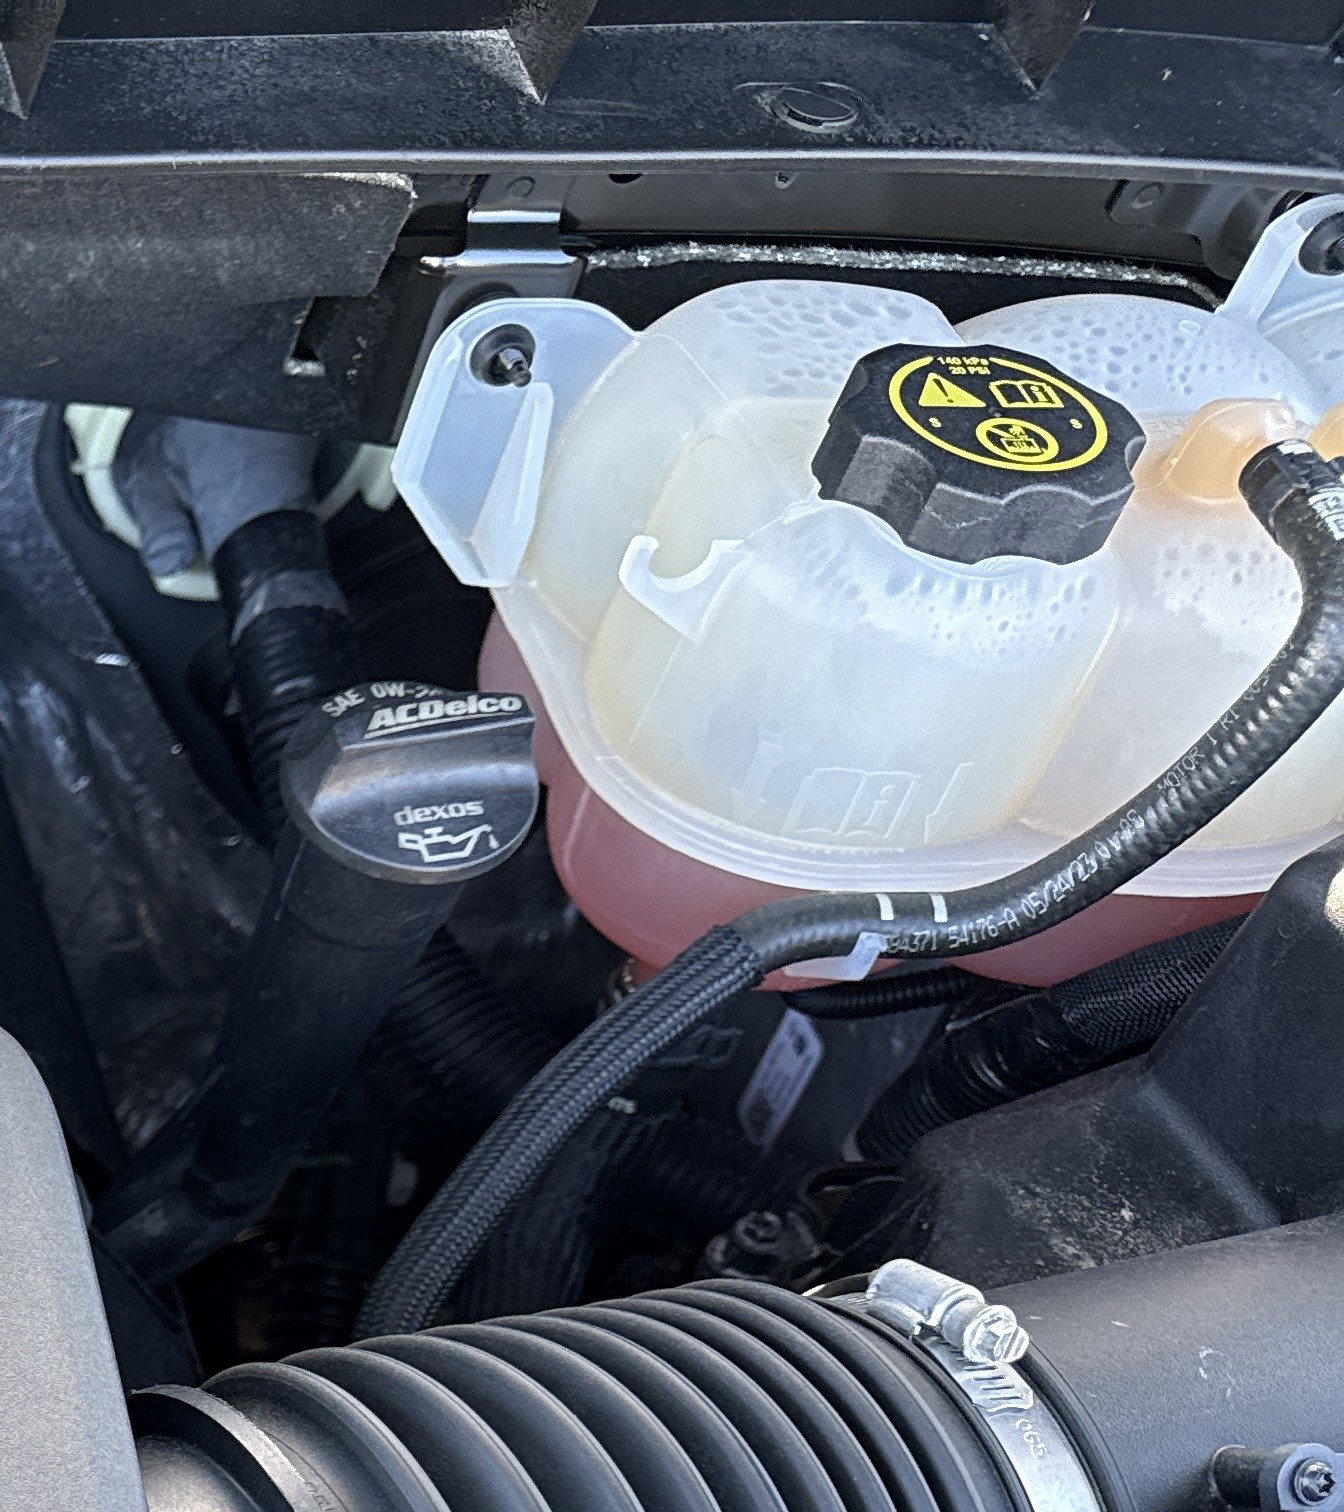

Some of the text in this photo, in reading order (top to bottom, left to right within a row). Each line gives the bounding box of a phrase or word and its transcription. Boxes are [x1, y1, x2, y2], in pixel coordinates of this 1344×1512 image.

[321, 687, 366, 717] SAE
[366, 694, 523, 731] ACDelco
[393, 800, 485, 826] dexos
